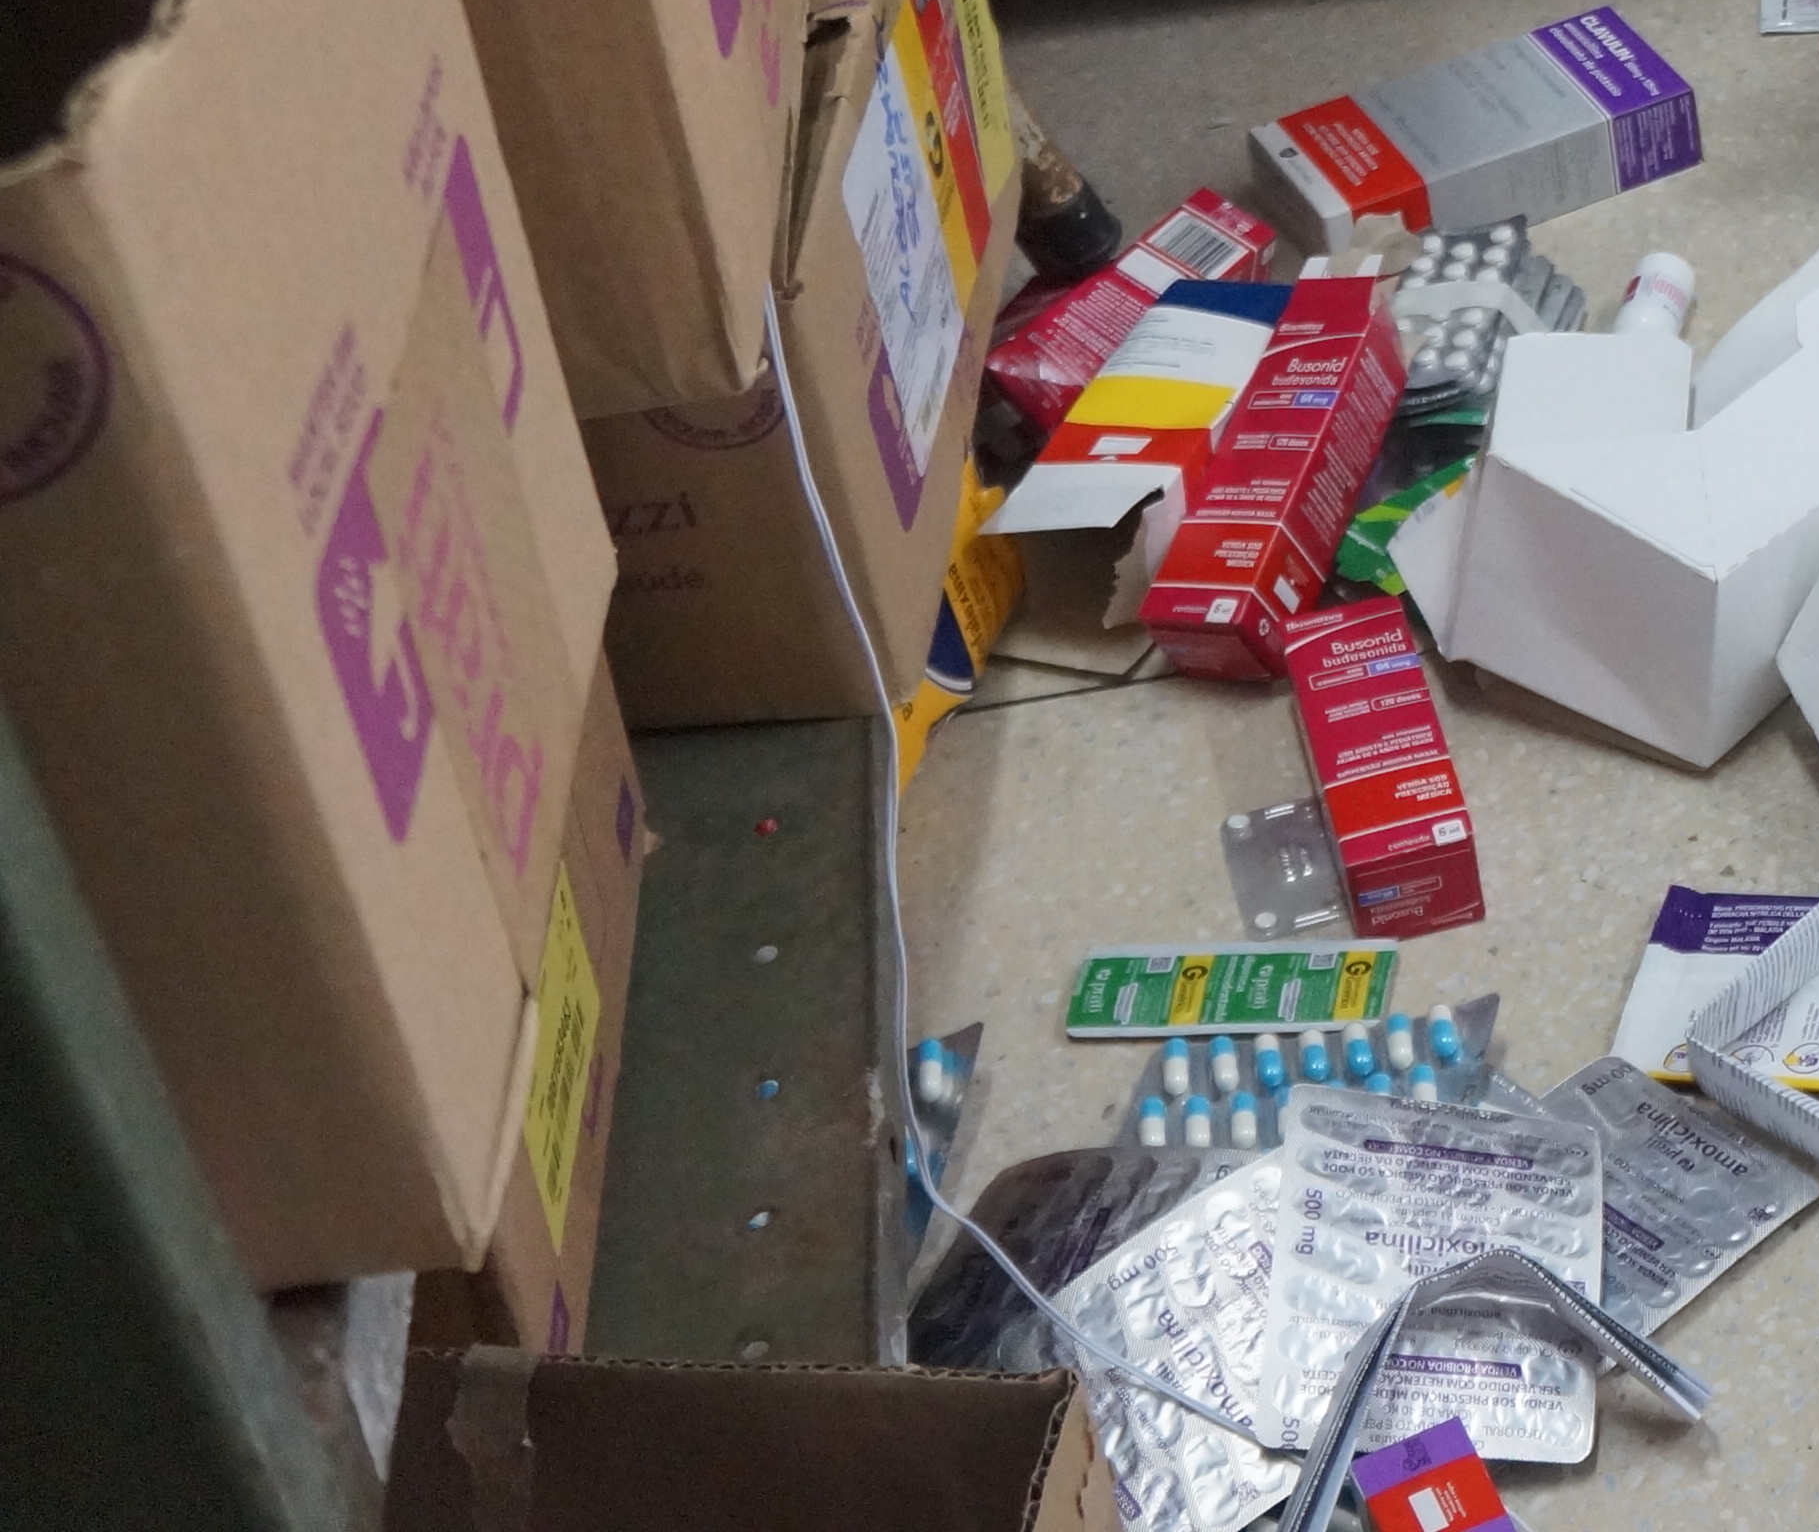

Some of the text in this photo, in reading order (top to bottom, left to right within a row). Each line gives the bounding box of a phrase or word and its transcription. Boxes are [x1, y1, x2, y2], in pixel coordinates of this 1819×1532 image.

[1580, 16, 1635, 62] CLAVULIN
[1287, 356, 1347, 374] Busonid
[1272, 372, 1339, 387] budesonida
[1331, 629, 1404, 656] Busonid
[1322, 642, 1407, 668] budesonida
[1581, 1076, 1610, 1096] mg
[1531, 1184, 1574, 1198] VENDA
[1295, 1187, 1324, 1257] 500 mg
[1106, 1243, 1178, 1291] 500 mg
[1427, 1359, 1478, 1375] PROIBIDA
[1480, 1361, 1517, 1376] VENDA
[1411, 1388, 1563, 1410] VENDA SOB PRESCRIÇÃO
